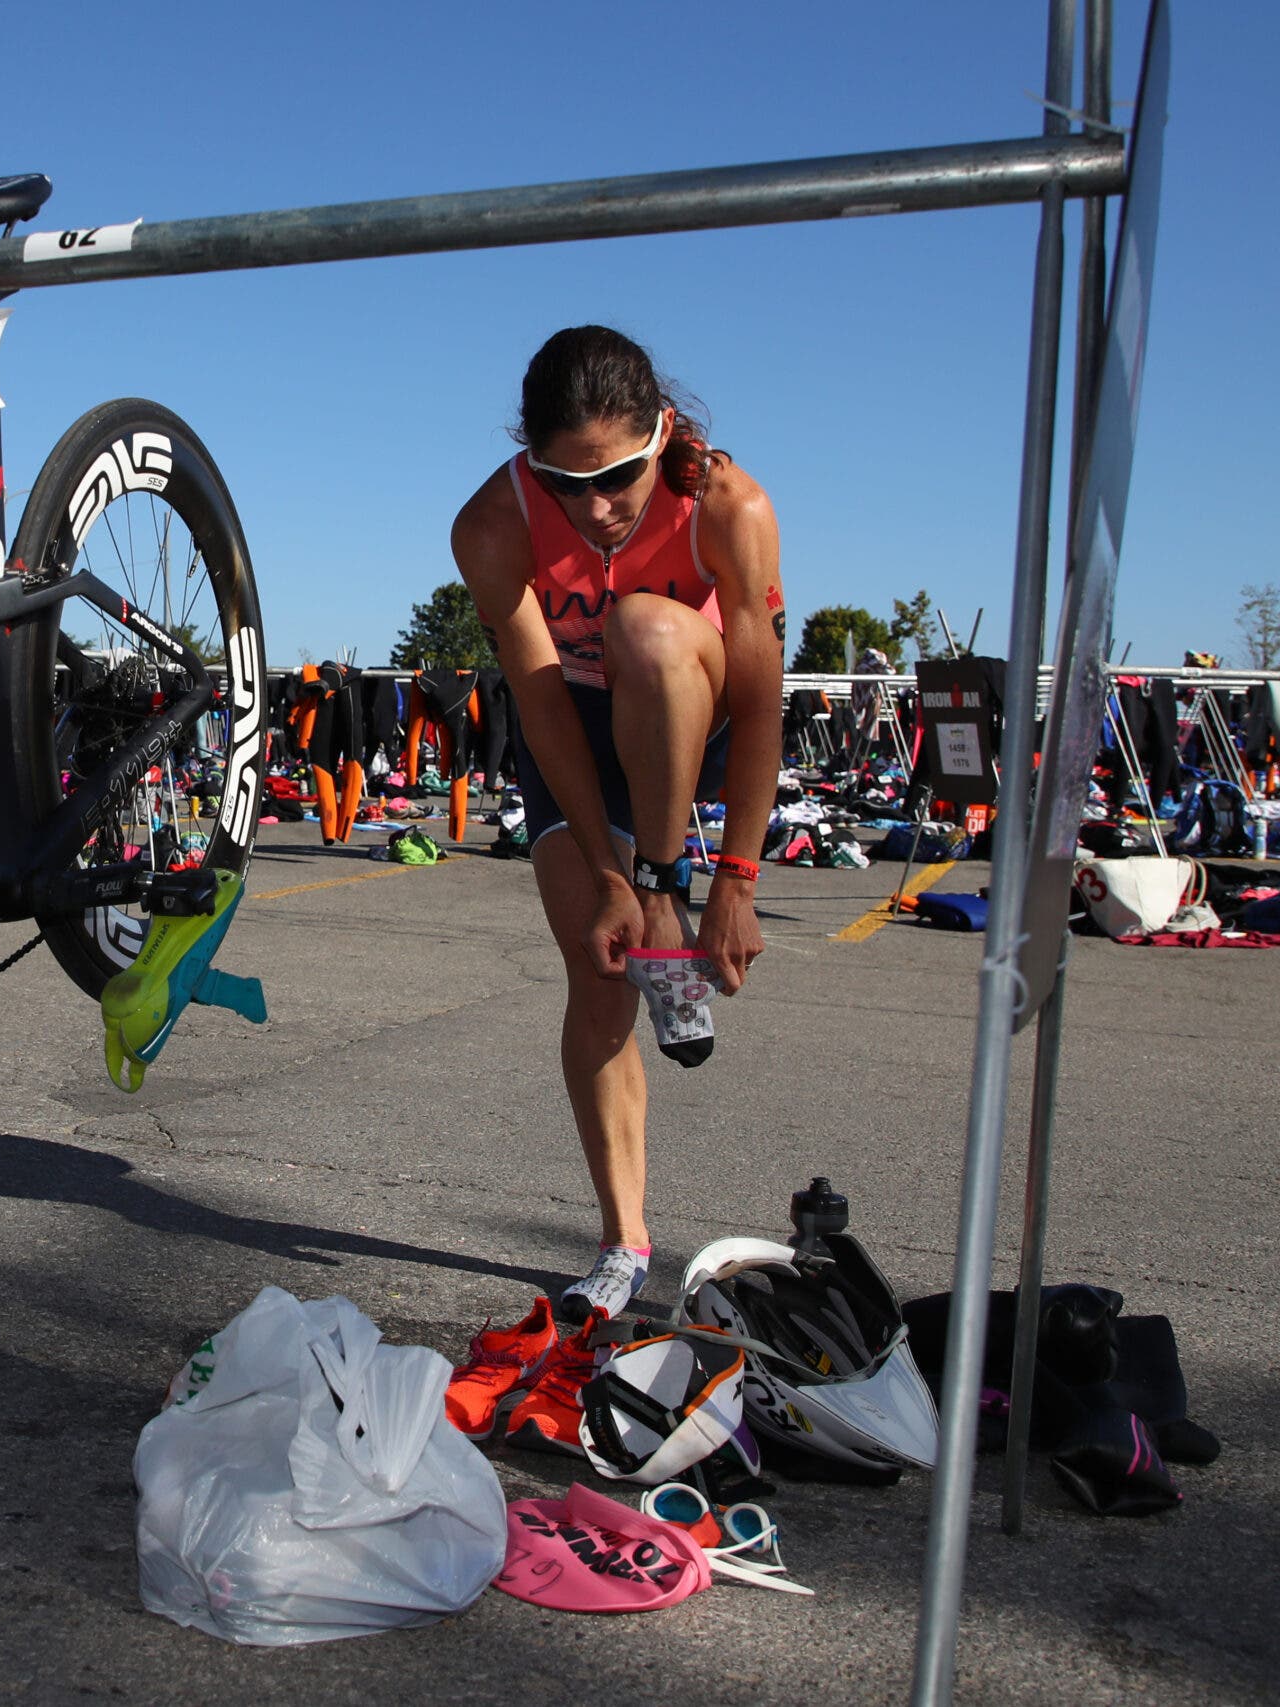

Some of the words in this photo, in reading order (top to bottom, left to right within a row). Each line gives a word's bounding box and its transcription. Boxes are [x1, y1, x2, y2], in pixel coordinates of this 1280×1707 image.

[147, 476, 164, 488] SES
[131, 612, 172, 647] ARGON
[171, 641, 184, 655] 18
[922, 683, 981, 708] IRONMAN
